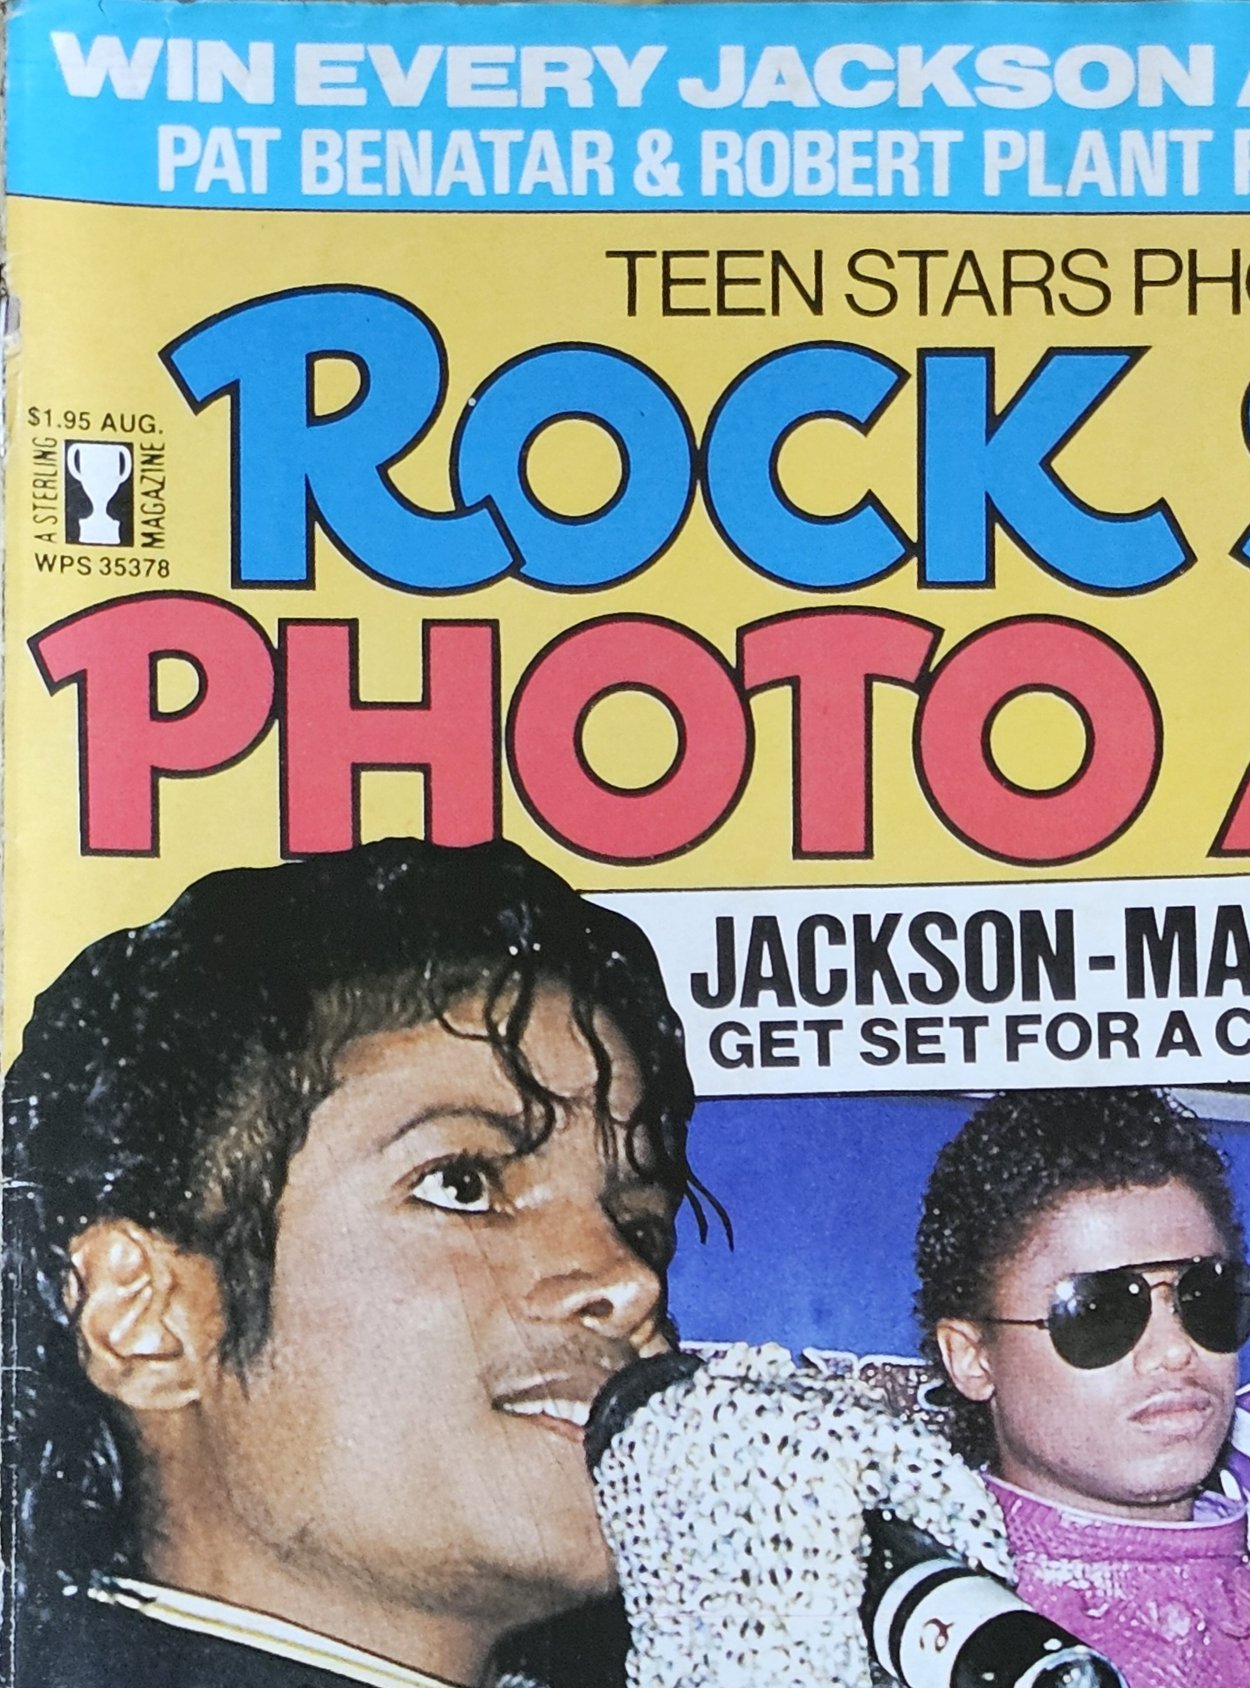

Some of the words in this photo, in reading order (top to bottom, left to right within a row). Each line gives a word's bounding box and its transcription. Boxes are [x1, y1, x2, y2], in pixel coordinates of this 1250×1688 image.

[51, 31, 274, 104] WIN
[295, 44, 667, 107] EVERY
[680, 44, 1213, 109] JACKSON
[159, 125, 280, 193] PAT
[301, 128, 614, 197] BENATAR
[634, 131, 682, 197] &
[701, 128, 957, 197] ROBERT
[984, 128, 1212, 197] PLANT
[606, 249, 823, 318] TEEN
[846, 248, 1110, 317] STARS
[28, 406, 91, 430] $1.95
[101, 413, 163, 434] AUG.
[160, 283, 1198, 598] ROCK
[32, 437, 58, 525] STERLING
[140, 443, 165, 549] MAGAZINE
[34, 532, 57, 543] A
[35, 552, 92, 575] WPS
[100, 557, 170, 578] 35378
[27, 589, 1164, 867] PHOTO
[709, 1017, 844, 1071] GET
[860, 1014, 989, 1065] SET
[1006, 1011, 1140, 1062] FOR
[1156, 1010, 1202, 1057] A
